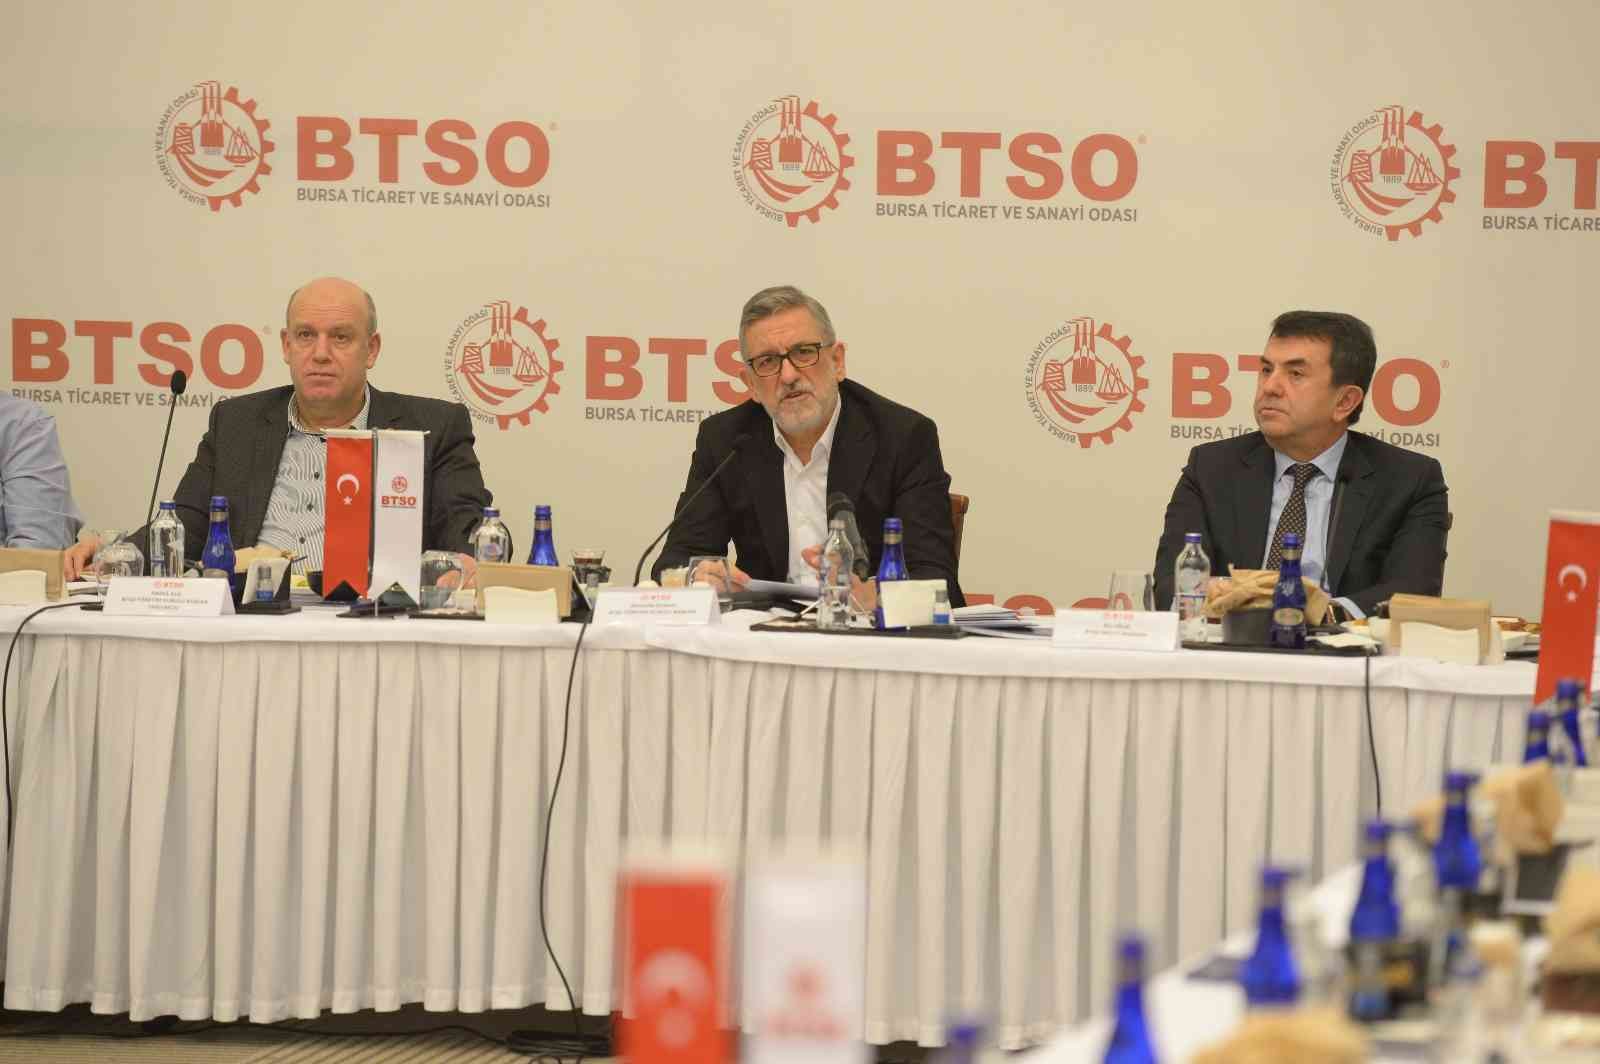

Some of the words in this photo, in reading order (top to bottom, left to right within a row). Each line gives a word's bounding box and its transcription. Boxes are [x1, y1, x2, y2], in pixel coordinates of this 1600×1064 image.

[296, 116, 550, 188] BTSO
[876, 130, 1138, 202] BTSO
[296, 188, 346, 202] BURSA
[352, 186, 416, 204] TİCARET
[419, 191, 440, 205] VE
[443, 190, 499, 207] SANAYİ
[503, 194, 550, 208] ODASI
[876, 203, 928, 218] BURSA
[933, 201, 998, 219] TİCARET
[1003, 206, 1022, 220] VE
[1026, 205, 1084, 221] SANAYİ
[1088, 208, 1137, 222] ODASI
[1482, 215, 1539, 231] BURSA
[12, 318, 264, 390] BTSO
[585, 336, 753, 405] BTS
[67, 387, 131, 406] TİCARET
[134, 392, 155, 407] VE
[585, 406, 637, 421] BURSA
[640, 405, 704, 423] TİCARET
[1170, 424, 1225, 440] BURSA
[1390, 431, 1440, 448] ODASI
[381, 495, 417, 506] BTSO
